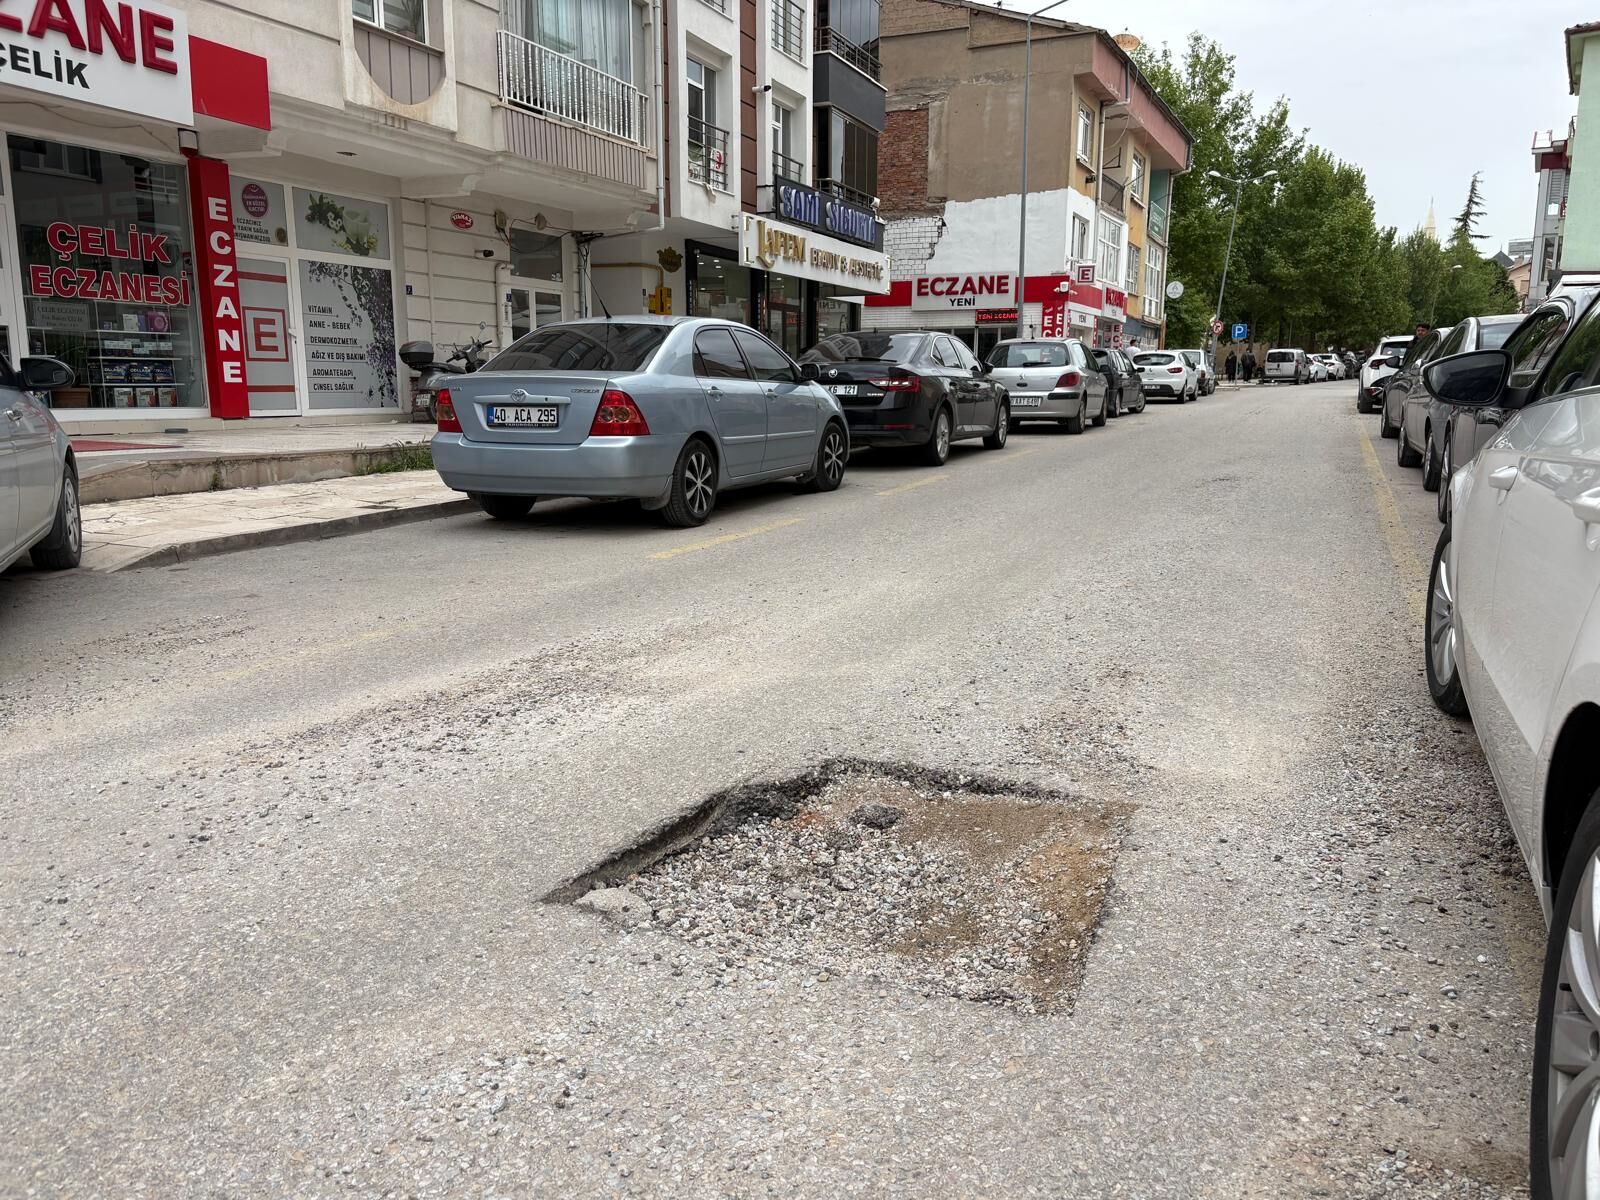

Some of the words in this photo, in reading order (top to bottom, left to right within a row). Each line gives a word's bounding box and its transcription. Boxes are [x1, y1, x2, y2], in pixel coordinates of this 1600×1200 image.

[46, 221, 172, 264] ÇELİK
[810, 247, 840, 271] BEAUTY
[1081, 269, 1091, 280] E
[29, 264, 190, 306] ECZANESİ
[207, 196, 243, 383] ECZANE
[916, 274, 1010, 297] ECZANE
[950, 295, 976, 307] YENİ
[309, 320, 326, 329] ANNE
[332, 321, 351, 330] BEBEK
[253, 317, 279, 352] E
[1235, 327, 1244, 337] P
[311, 350, 326, 360] AĞIZ
[327, 352, 334, 360] VE
[335, 352, 346, 362] DİŞ
[346, 352, 366, 361] BAKIMI
[313, 382, 334, 391] CİNSEL
[334, 381, 354, 391] SAĞLIK
[844, 385, 856, 394] 121
[494, 408, 506, 422] 40
[514, 408, 532, 422] ACA
[537, 408, 556, 422] 295
